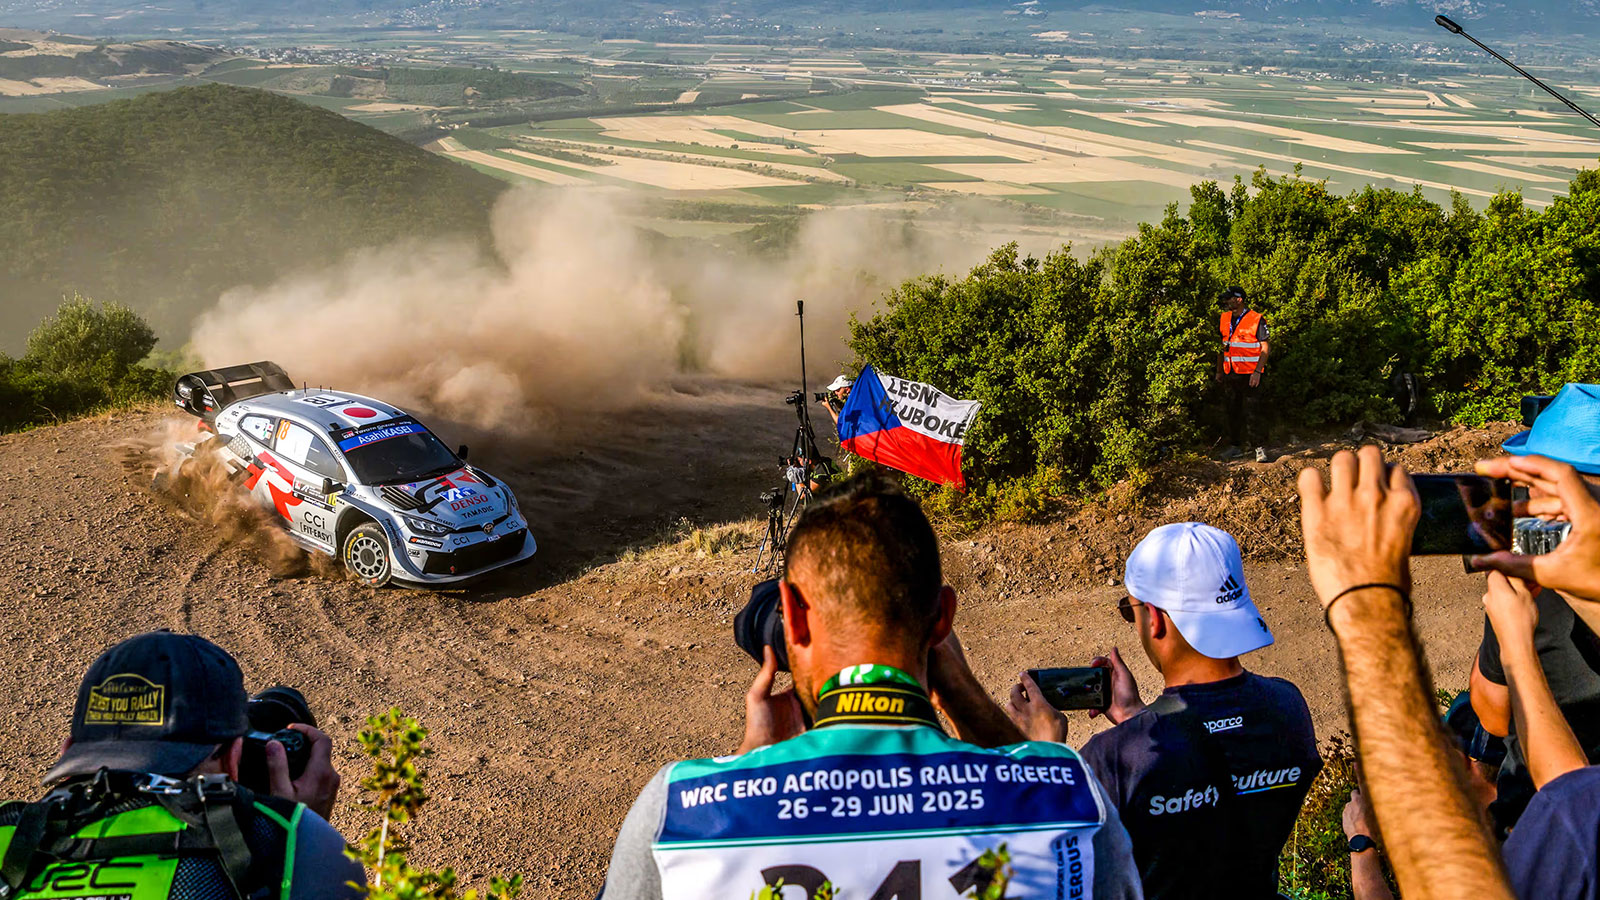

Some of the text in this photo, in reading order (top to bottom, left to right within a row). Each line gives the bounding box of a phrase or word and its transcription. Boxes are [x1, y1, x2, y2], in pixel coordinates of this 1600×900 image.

[887, 377, 942, 408] LESNÍ
[276, 419, 291, 441] 18
[451, 494, 488, 511] DENSO
[461, 506, 494, 519] TAMADIC
[131, 690, 160, 711] RALLY
[836, 692, 904, 713] Nikon
[680, 764, 1076, 809] WRC EKO ACROPOLIS RALLY GREECE
[867, 793, 914, 816] JUN
[921, 789, 985, 812] 2025
[1066, 836, 1083, 900] EROUS
